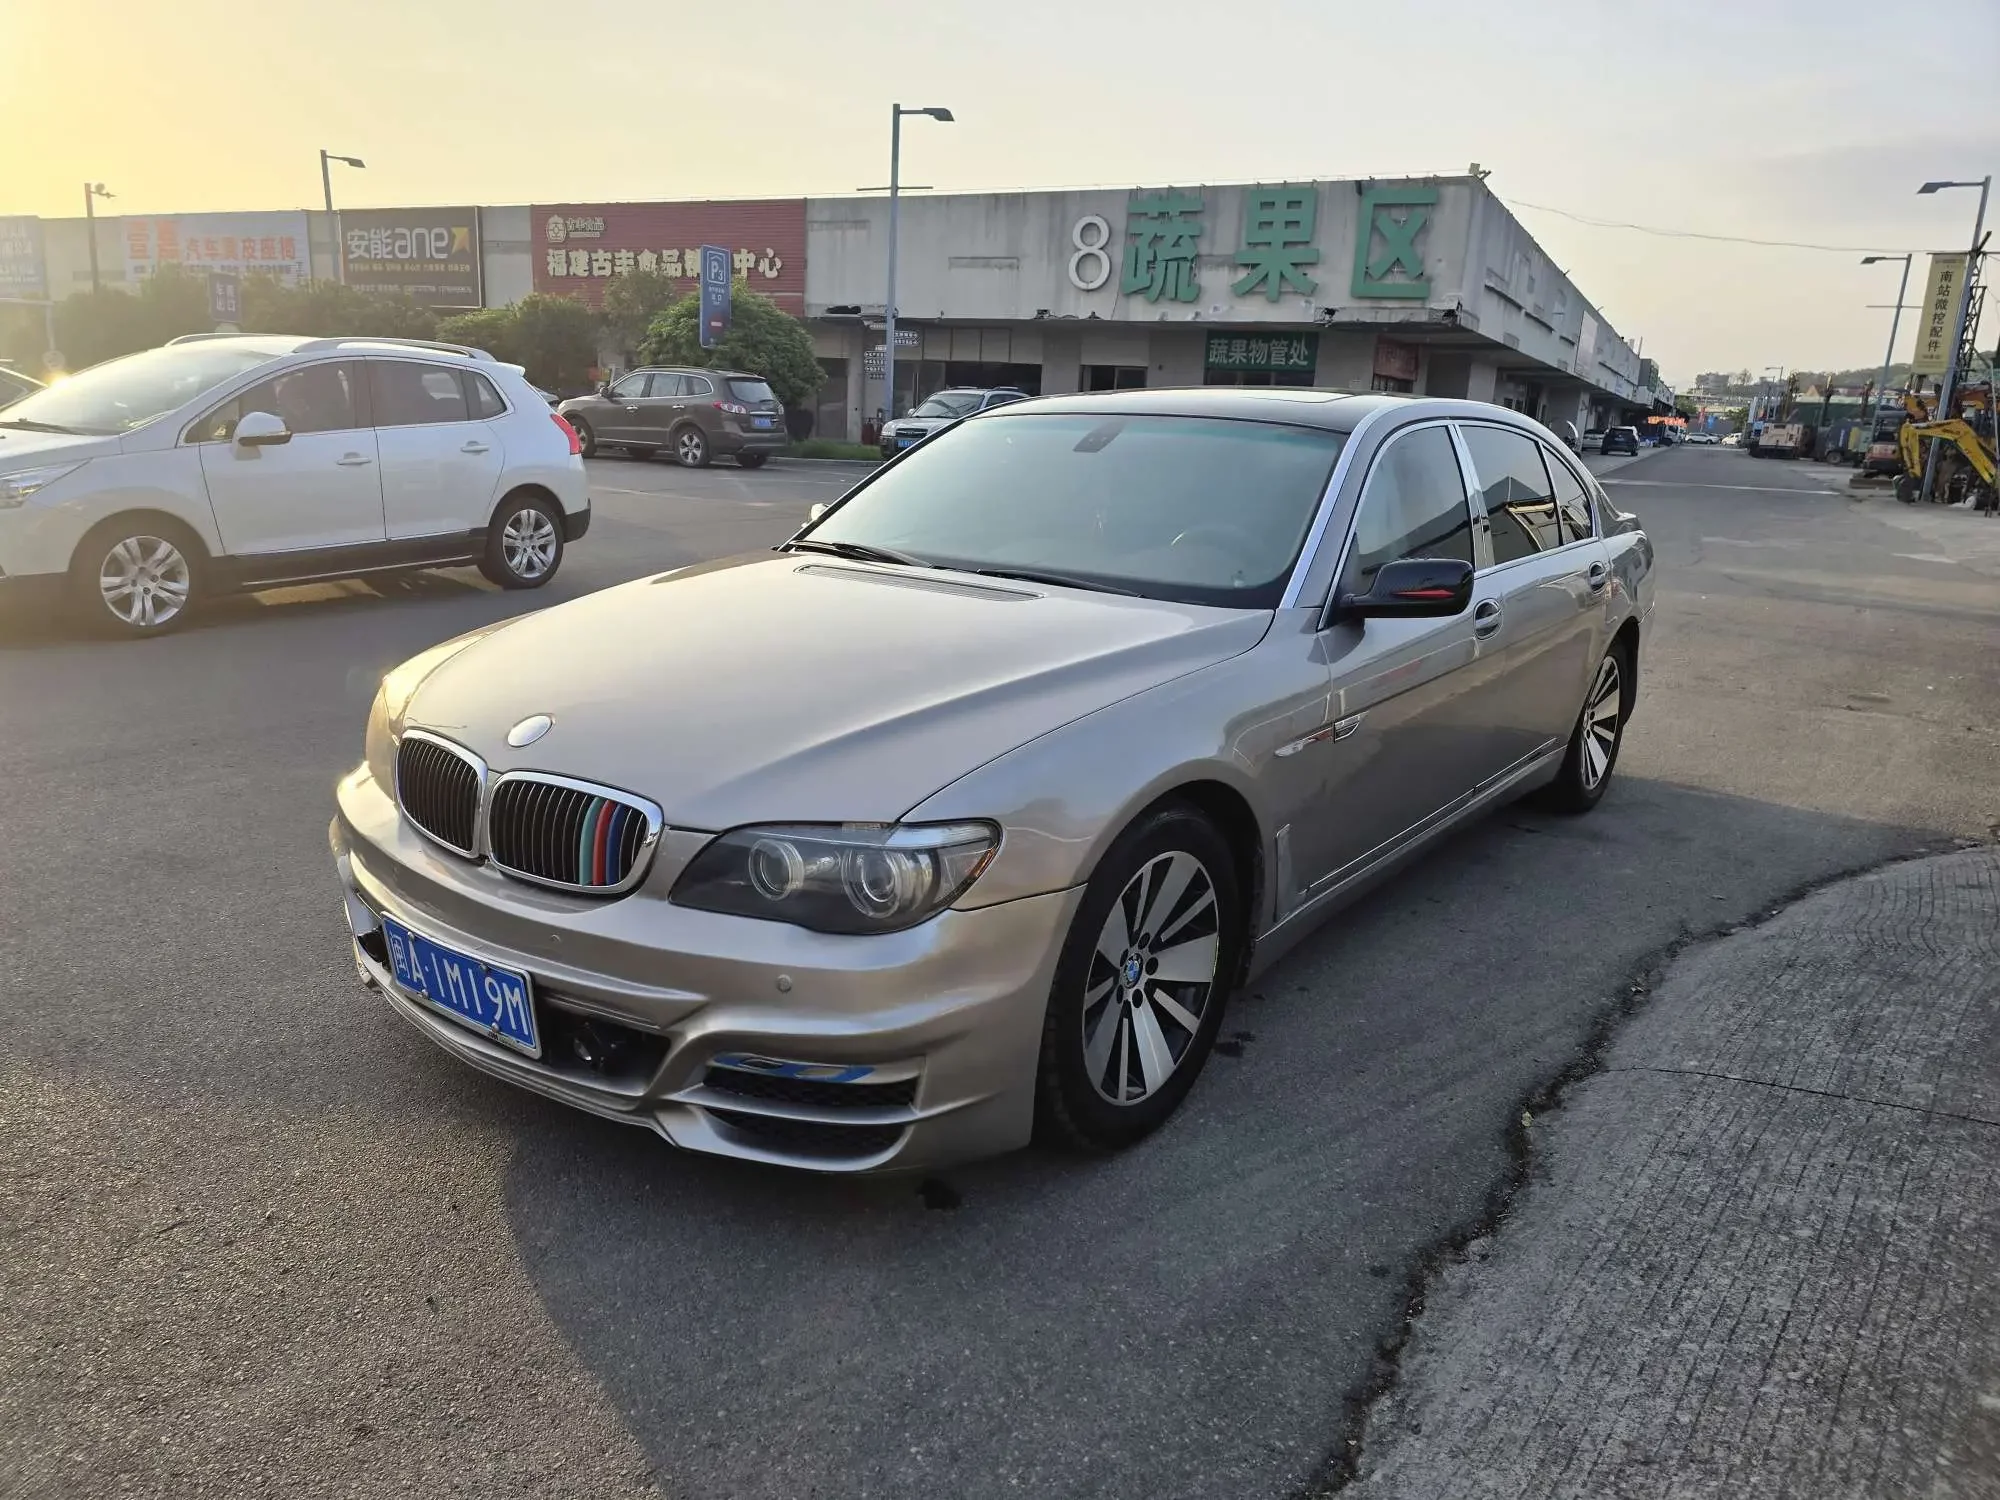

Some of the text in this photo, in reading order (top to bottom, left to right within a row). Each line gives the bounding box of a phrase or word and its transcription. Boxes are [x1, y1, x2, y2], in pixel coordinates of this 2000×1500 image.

[1068, 186, 1440, 303] 8 蔬果区
[1209, 338, 1309, 366] 蔬果物管处
